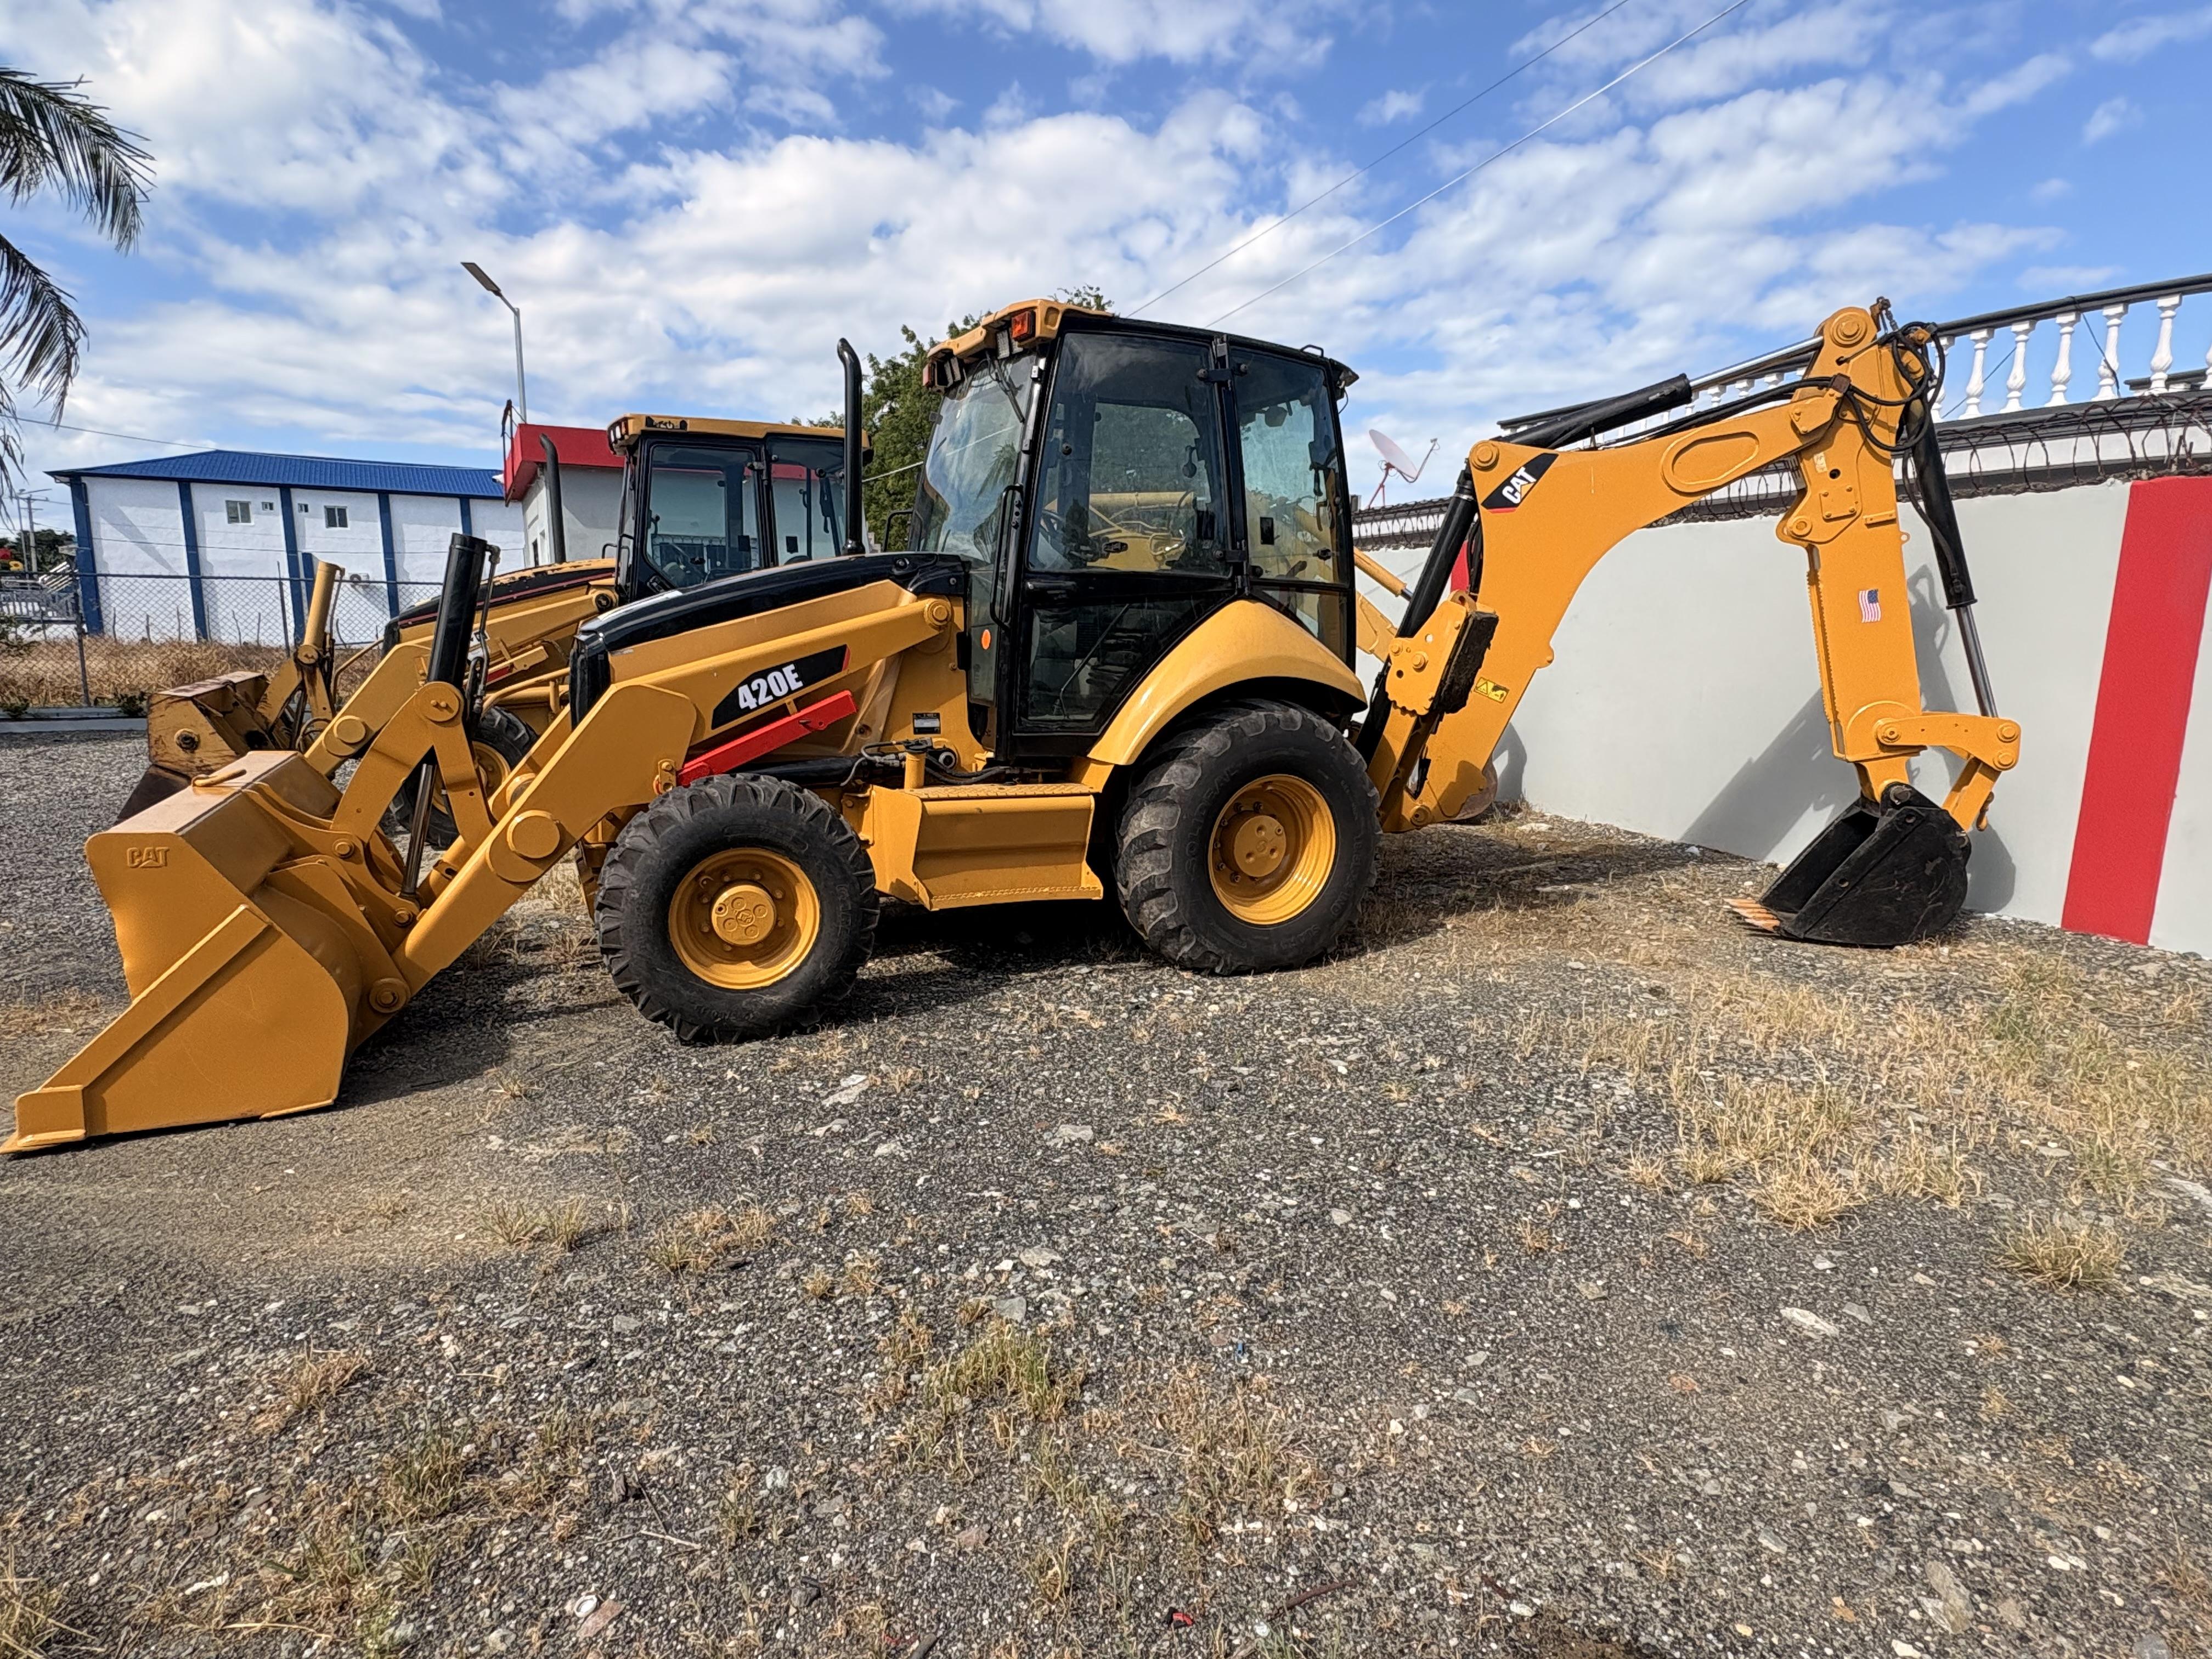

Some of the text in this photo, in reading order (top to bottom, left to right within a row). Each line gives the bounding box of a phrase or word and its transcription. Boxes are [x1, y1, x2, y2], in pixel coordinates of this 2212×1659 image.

[1502, 466, 1537, 504] CAT
[738, 664, 803, 709] 420E
[126, 847, 170, 868] CAT
